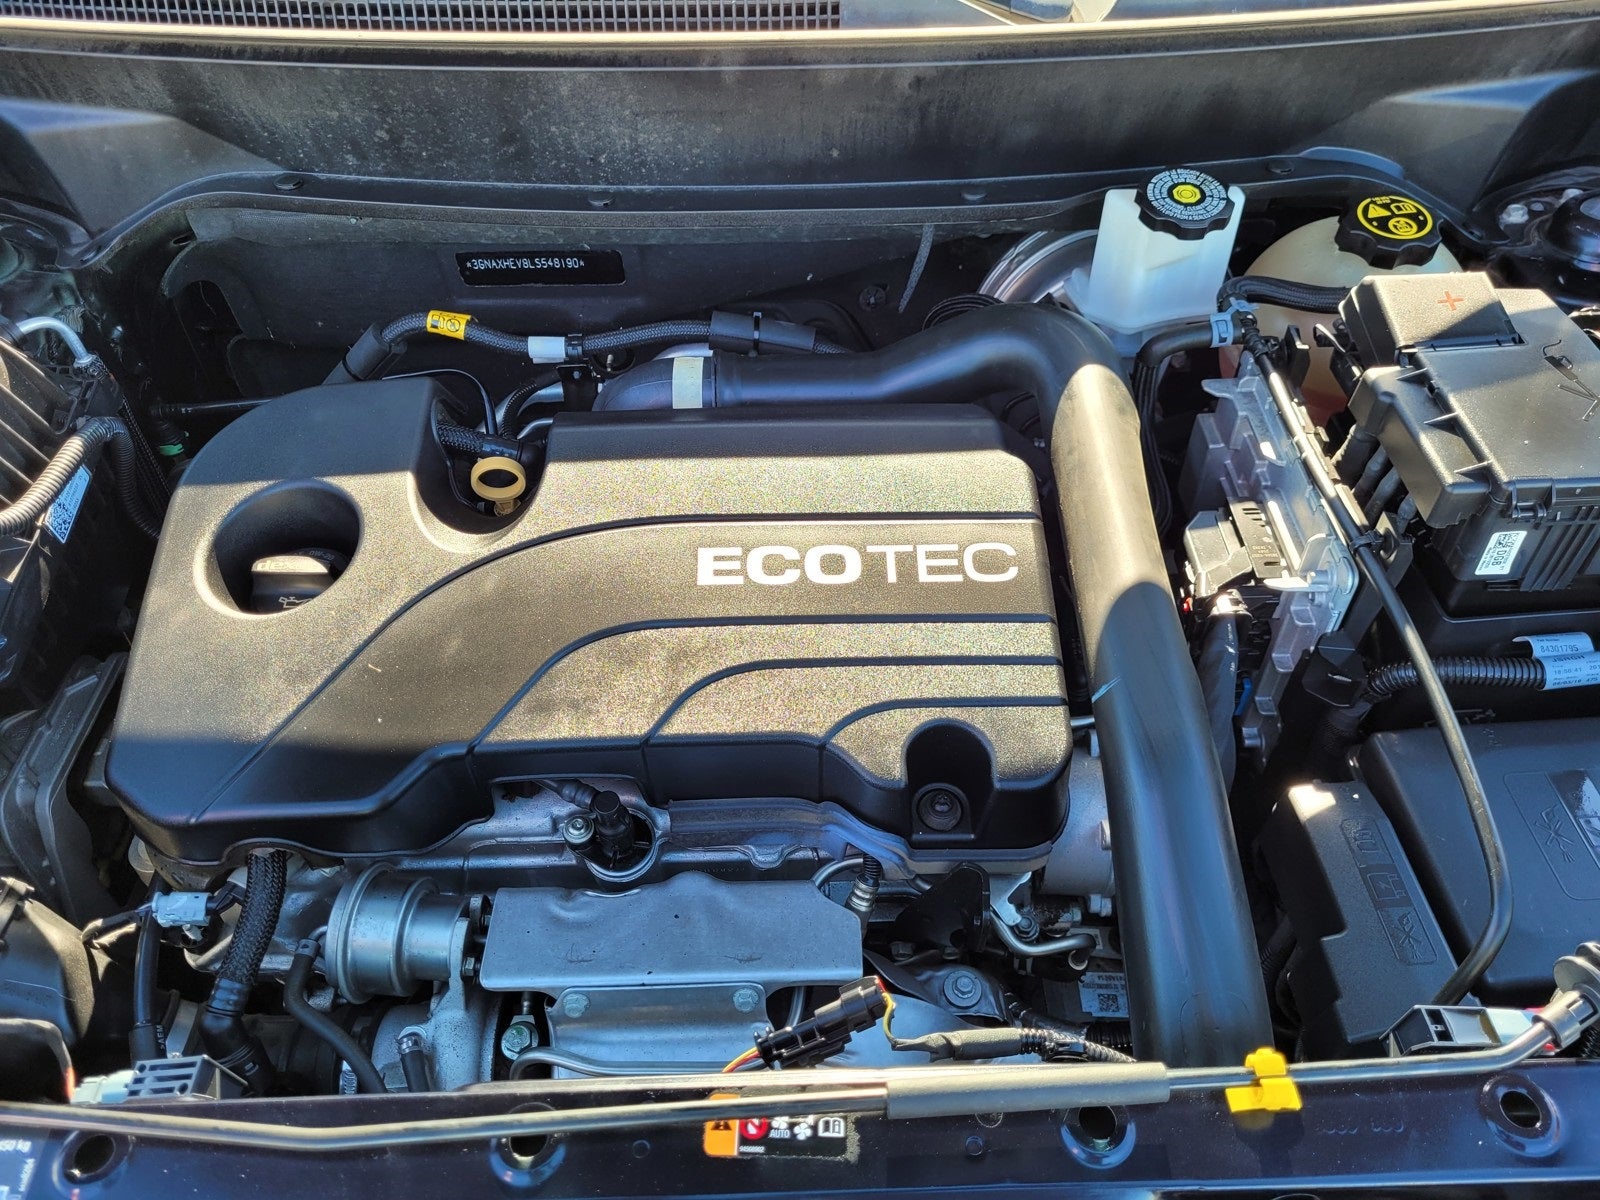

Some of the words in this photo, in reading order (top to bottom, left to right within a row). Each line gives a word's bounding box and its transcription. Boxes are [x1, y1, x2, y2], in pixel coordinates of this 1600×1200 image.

[697, 542, 1019, 586] ECOTEC
[1540, 644, 1579, 653] 84301795
[769, 1129, 790, 1138] AUTO
